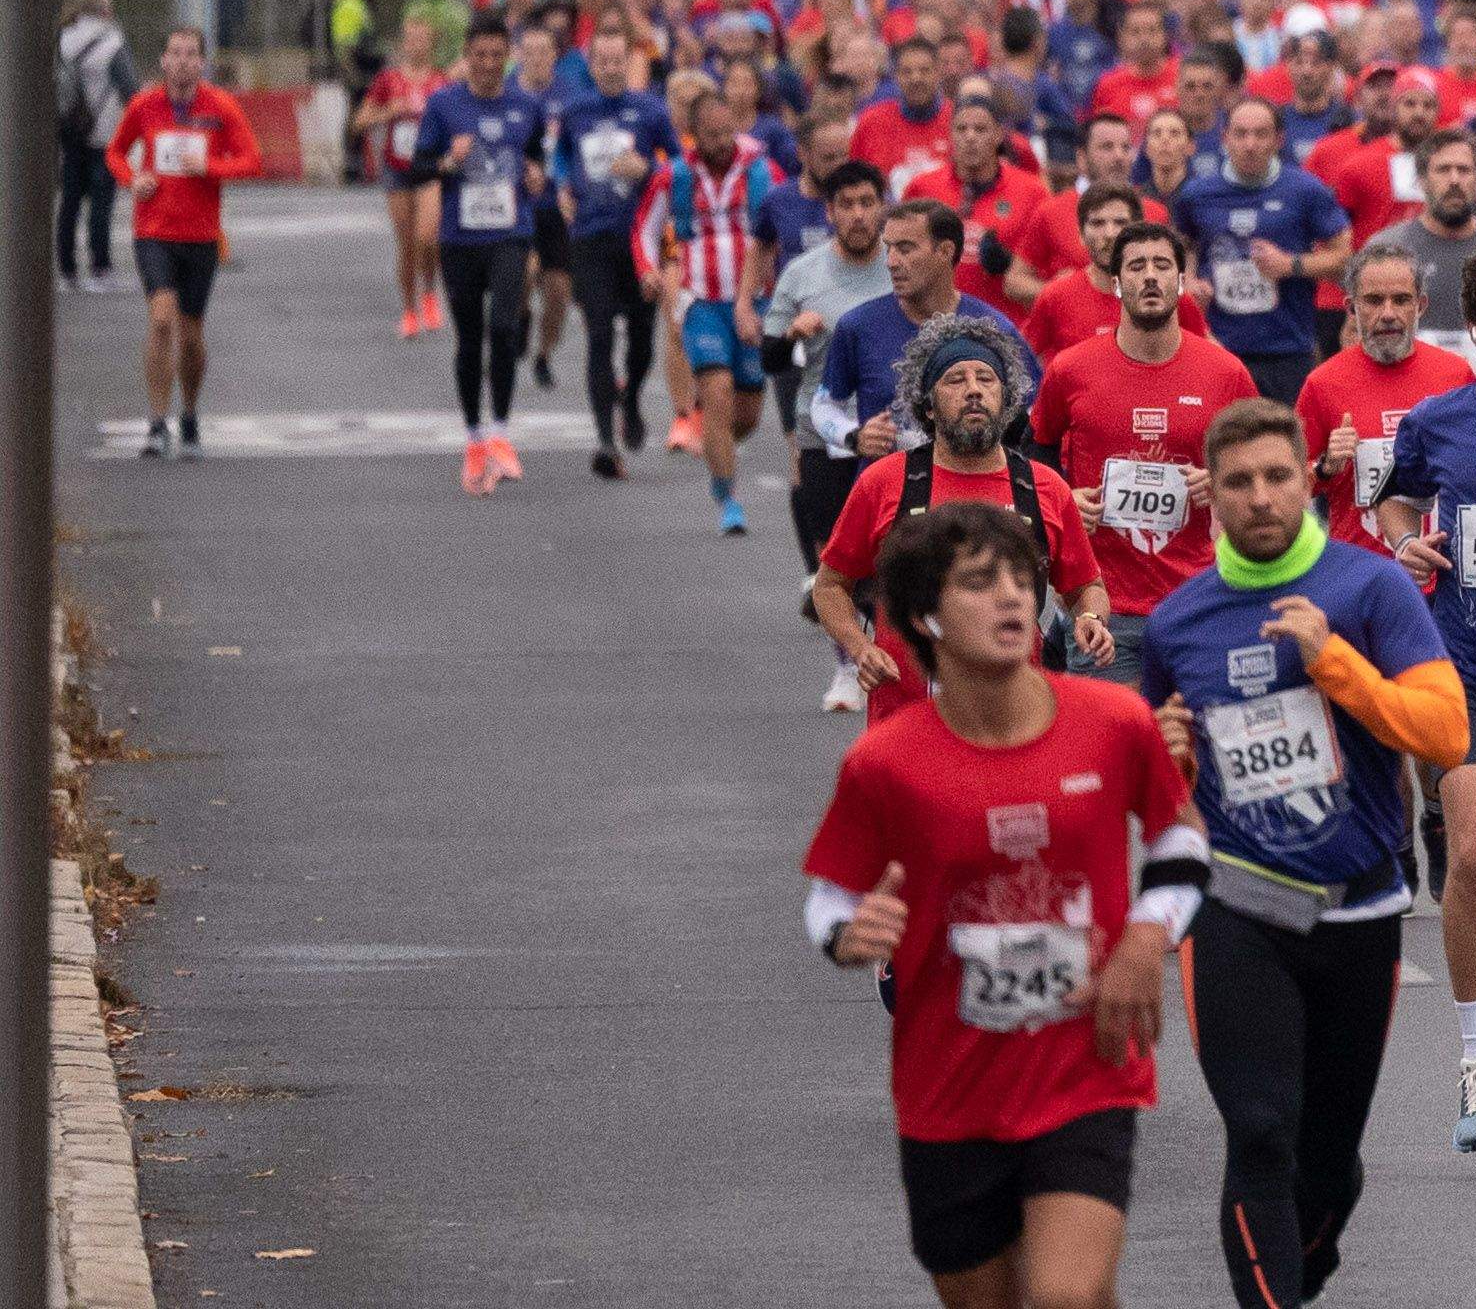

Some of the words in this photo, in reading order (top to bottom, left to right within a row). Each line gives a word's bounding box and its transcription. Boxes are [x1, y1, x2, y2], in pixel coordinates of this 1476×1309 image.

[1117, 489, 1175, 516] 7109
[1228, 731, 1318, 780] 3884
[977, 963, 1075, 1003] 2245
